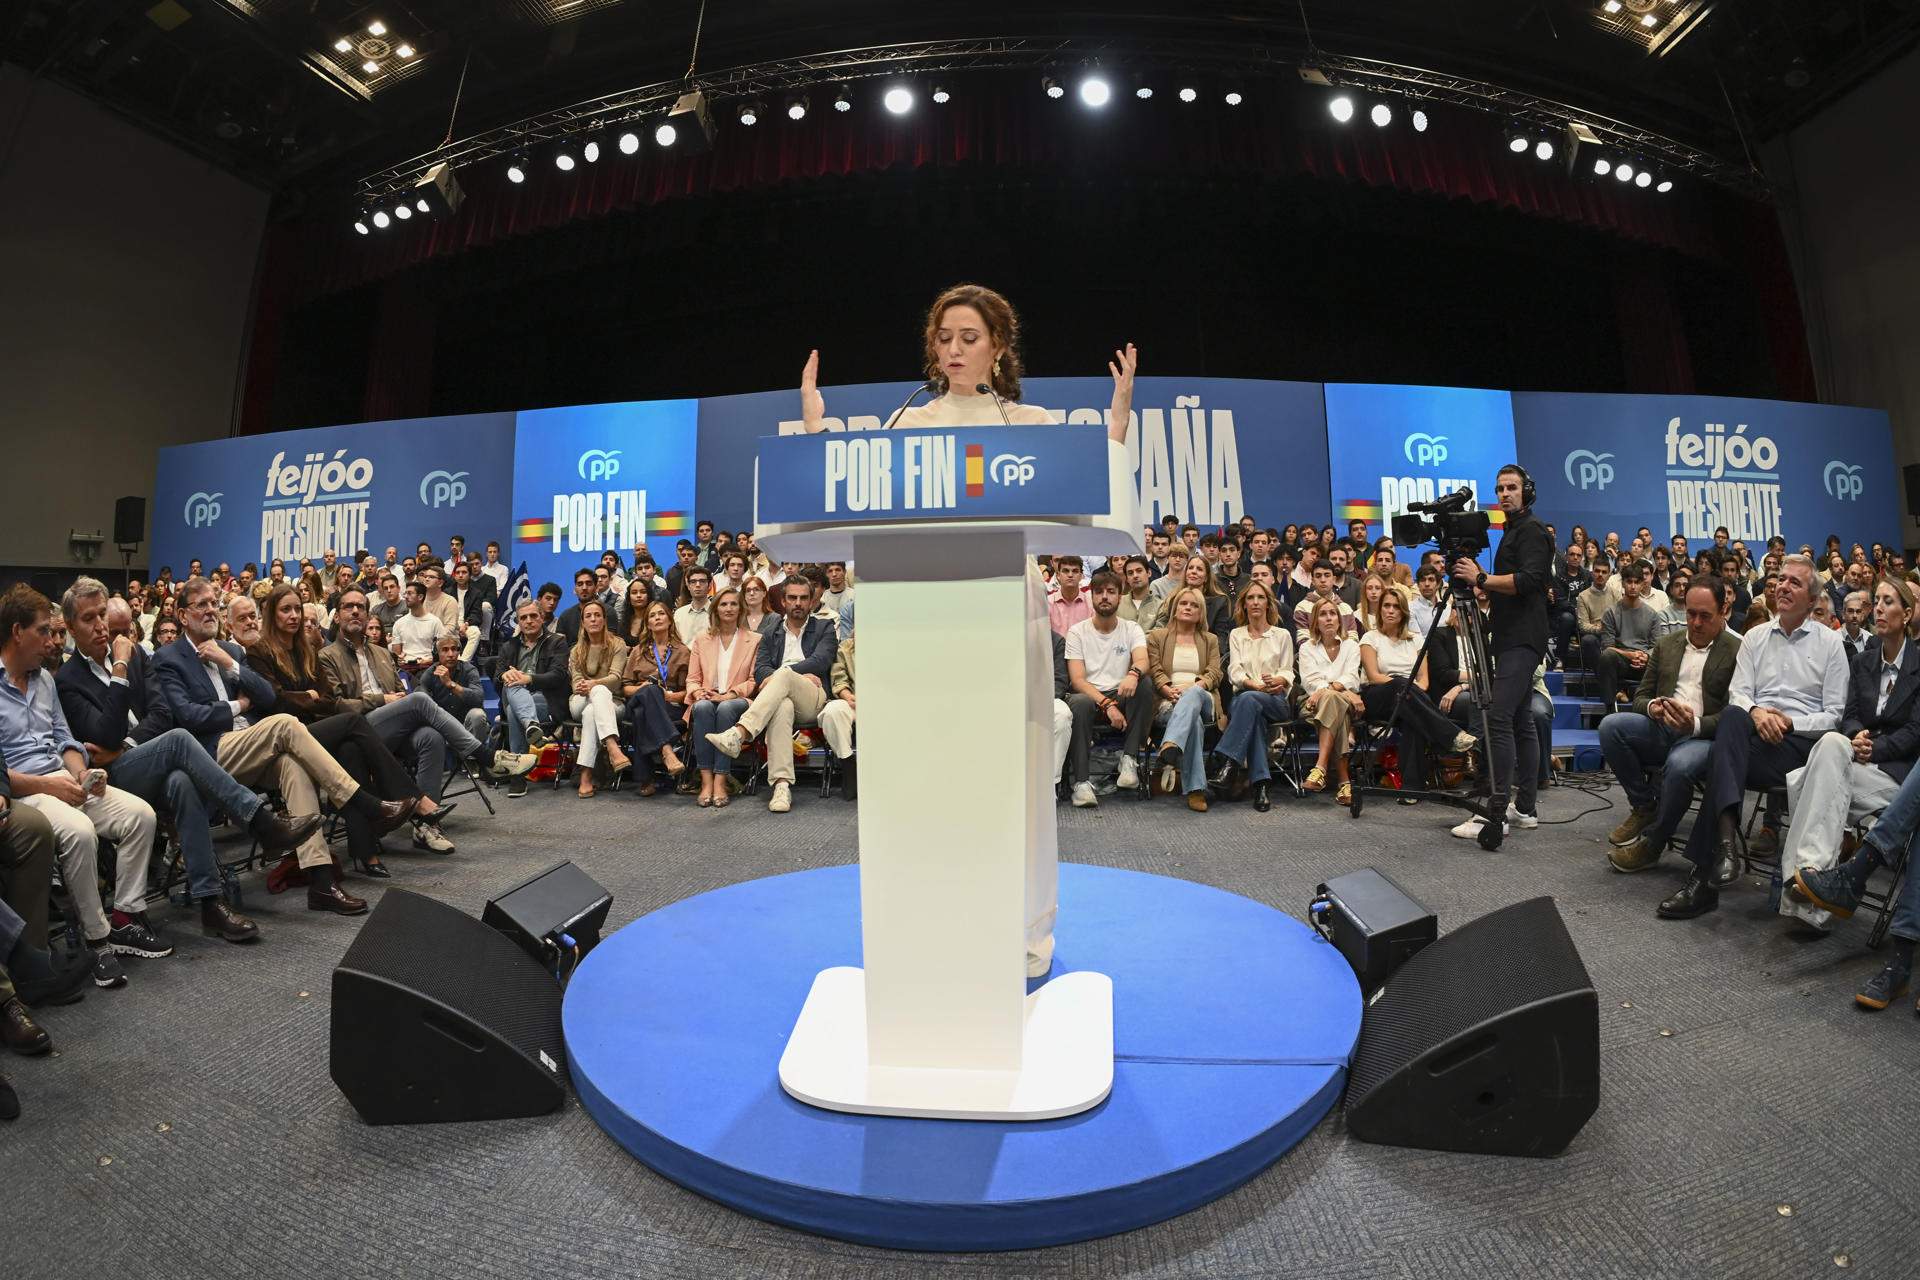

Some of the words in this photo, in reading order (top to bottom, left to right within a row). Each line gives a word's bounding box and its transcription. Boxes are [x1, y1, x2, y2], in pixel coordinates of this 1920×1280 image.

[1417, 444, 1448, 466] pp
[1665, 417, 1779, 479] feijóo
[265, 449, 374, 505] feijóo
[590, 458, 620, 481] pp
[825, 437, 892, 512] POR
[904, 435, 957, 510] FIN
[1003, 464, 1035, 486] pp
[1580, 463, 1615, 490] pp
[433, 481, 467, 508] pp
[1836, 474, 1864, 501] pp
[195, 503, 222, 528] pp
[552, 492, 603, 553] POR
[607, 490, 647, 550] FIN
[1667, 480, 1784, 541] PRESIDENTE
[261, 502, 370, 563] PRESIDENTE
